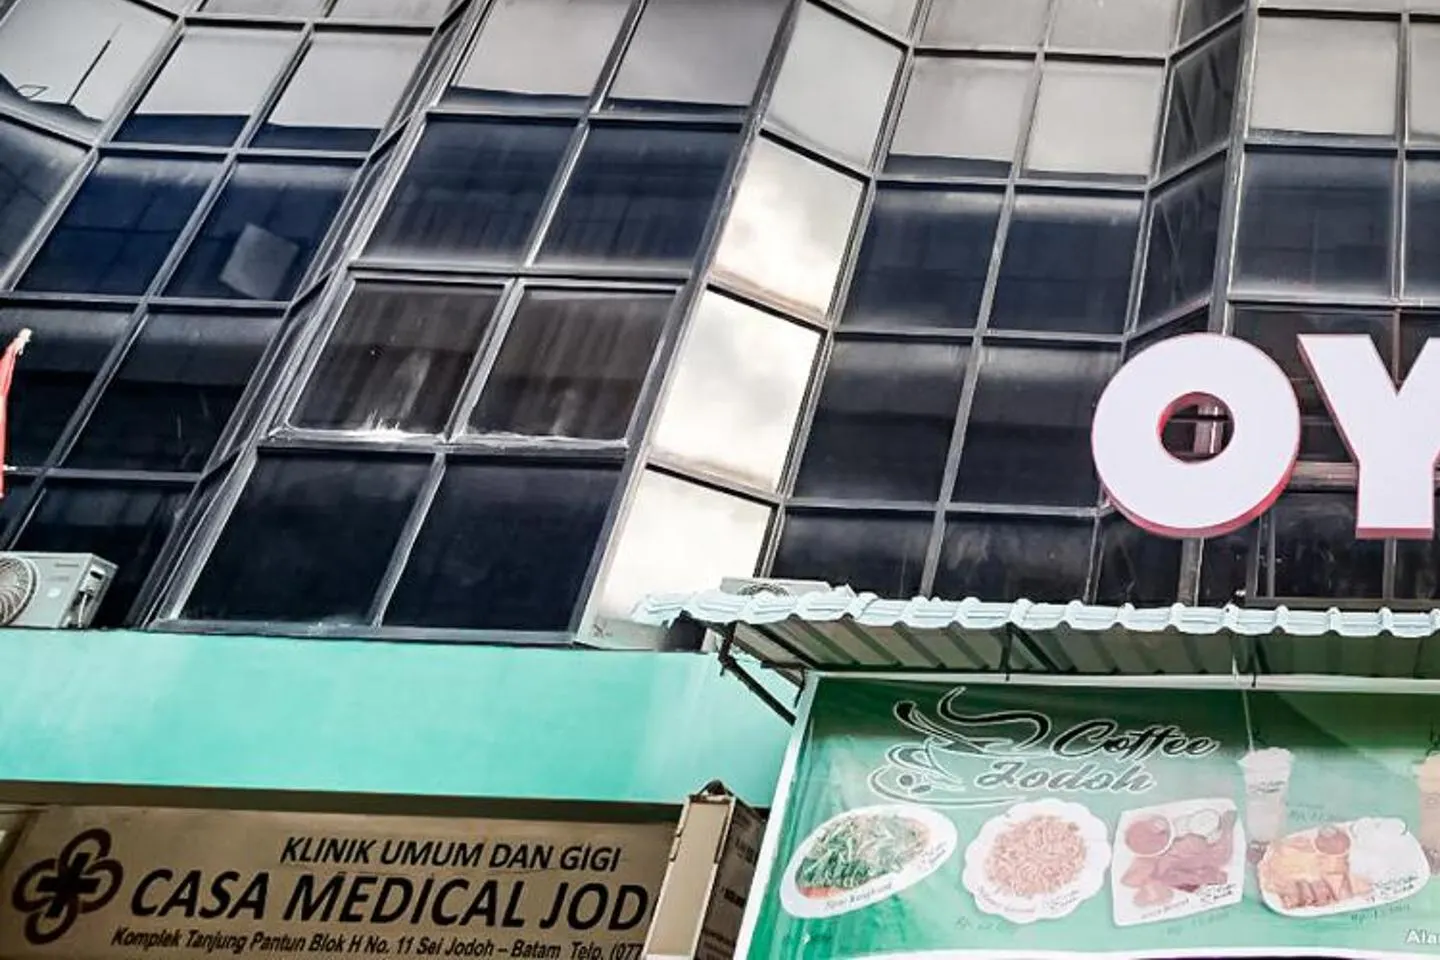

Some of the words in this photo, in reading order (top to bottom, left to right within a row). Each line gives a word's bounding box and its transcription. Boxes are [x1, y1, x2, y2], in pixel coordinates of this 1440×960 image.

[1051, 719, 1219, 760] Coffee
[279, 836, 376, 864] KLINIK
[380, 839, 484, 868] UMUM
[488, 843, 554, 870] DAN
[559, 846, 622, 873] GIGI
[130, 868, 270, 920] CASA
[282, 873, 526, 929] MEDICAL
[538, 881, 659, 931] JOD
[110, 925, 181, 949] Komplek
[184, 928, 249, 954] Tanjung
[250, 930, 306, 952] Pantun
[307, 933, 346, 952] Blok
[347, 936, 364, 953] H
[366, 936, 391, 954] No.
[398, 936, 414, 954] 11
[445, 937, 495, 958] Jodoh
[510, 939, 562, 959] Batam
